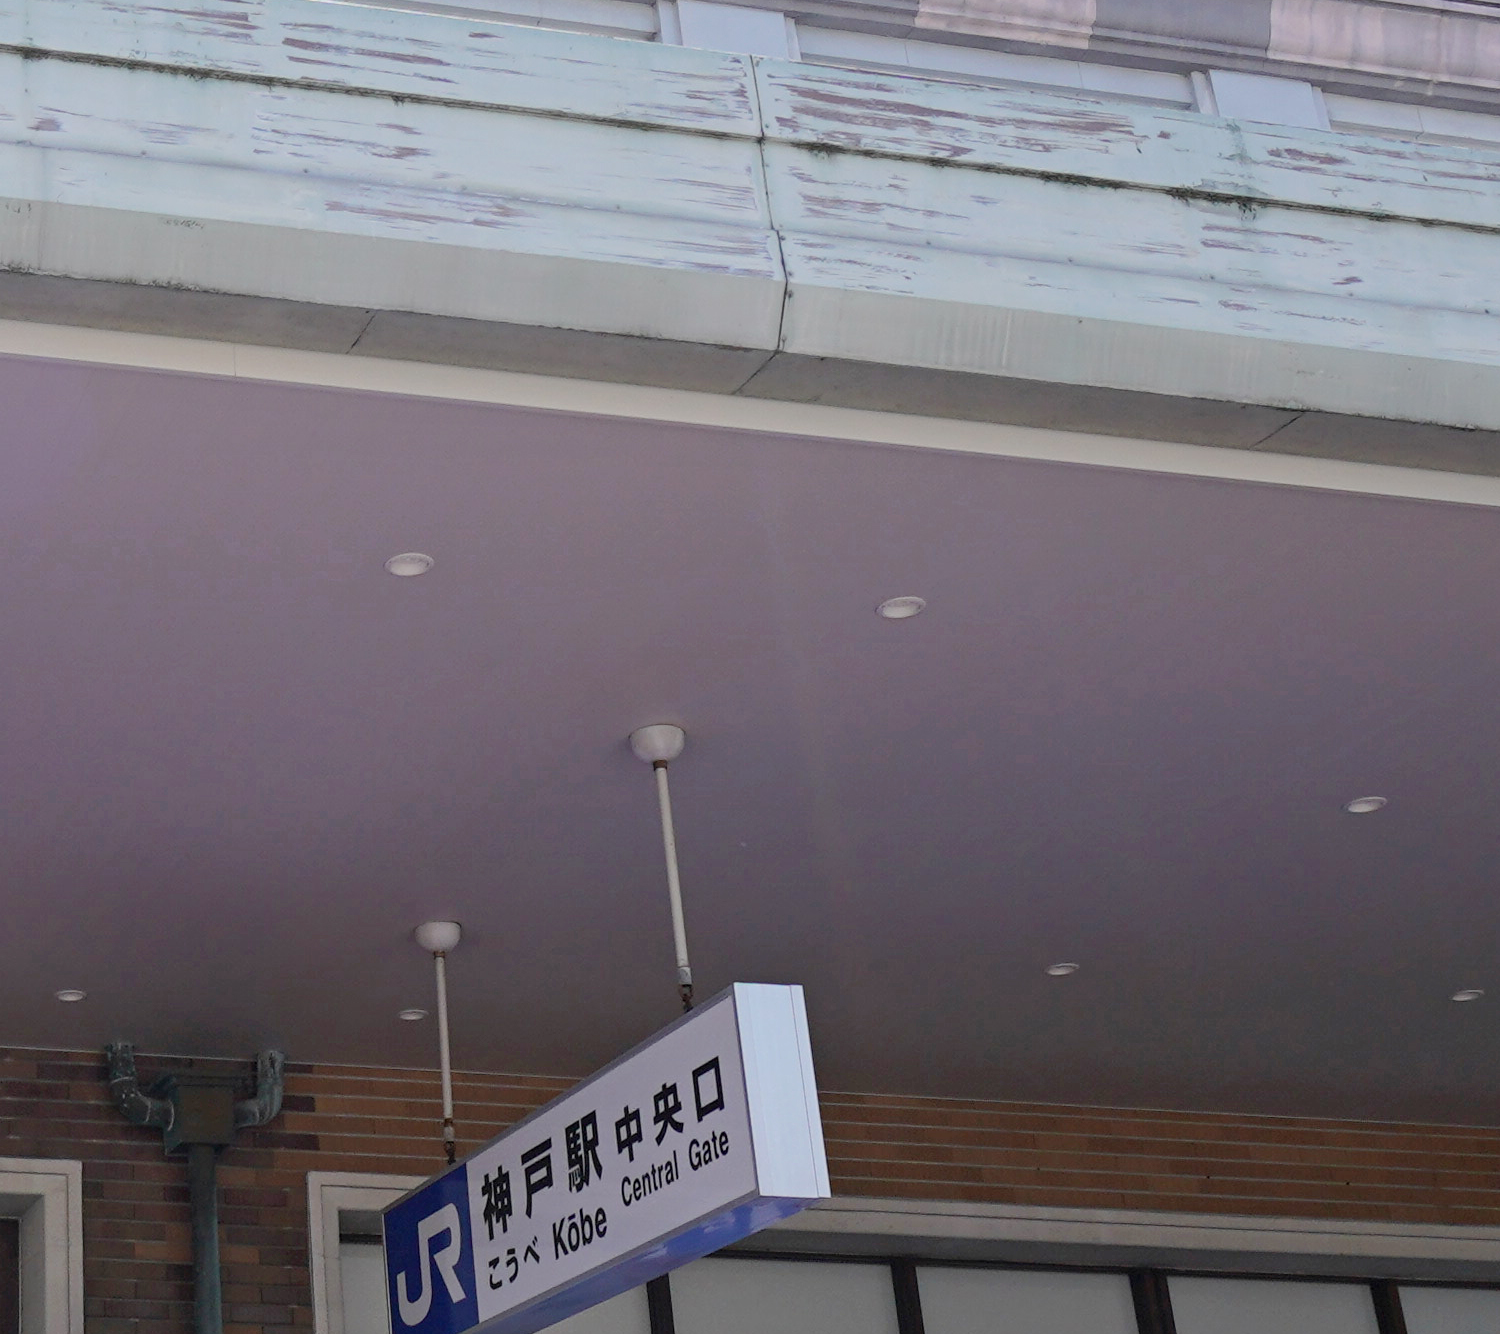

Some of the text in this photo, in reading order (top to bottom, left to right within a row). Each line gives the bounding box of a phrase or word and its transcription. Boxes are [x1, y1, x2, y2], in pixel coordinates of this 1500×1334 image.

[396, 1202, 467, 1327] JR
[488, 1127, 731, 1291] こうべ Kōbe Central Gate
